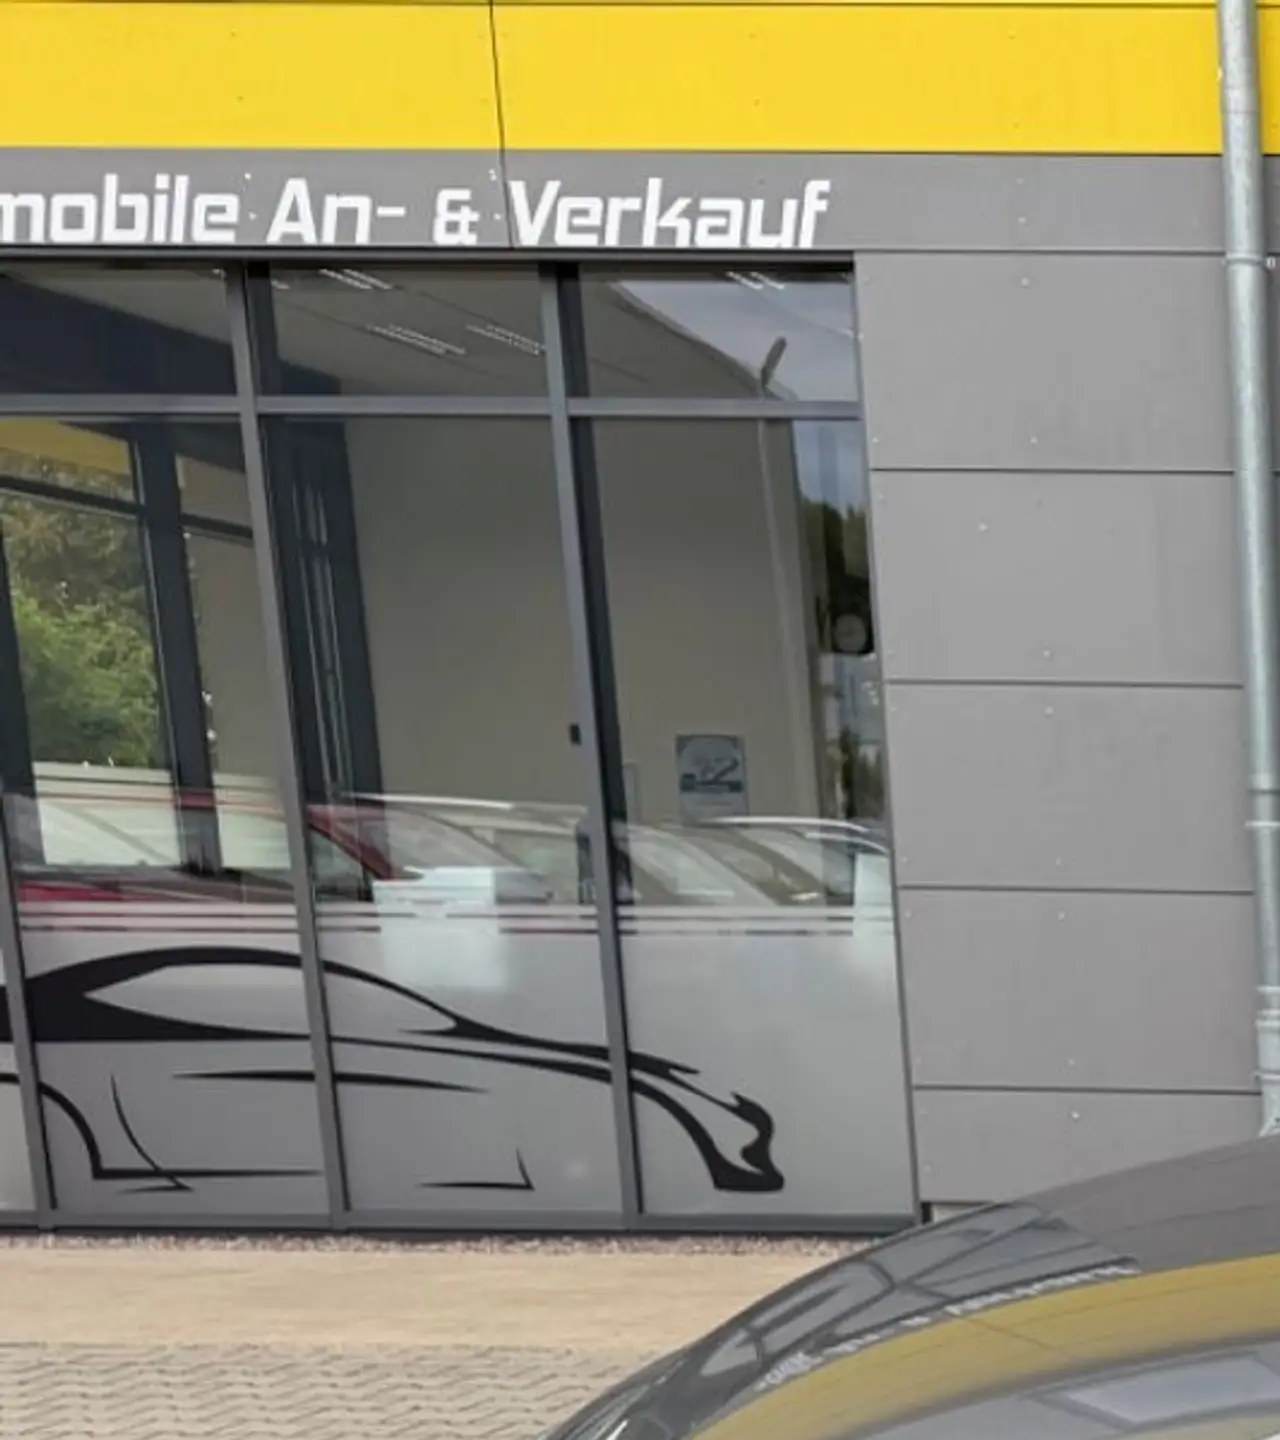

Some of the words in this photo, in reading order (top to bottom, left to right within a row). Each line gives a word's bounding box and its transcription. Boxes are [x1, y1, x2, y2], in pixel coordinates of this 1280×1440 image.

[266, 177, 406, 245] An-
[433, 188, 480, 246] &
[509, 178, 831, 249] Verkauf
